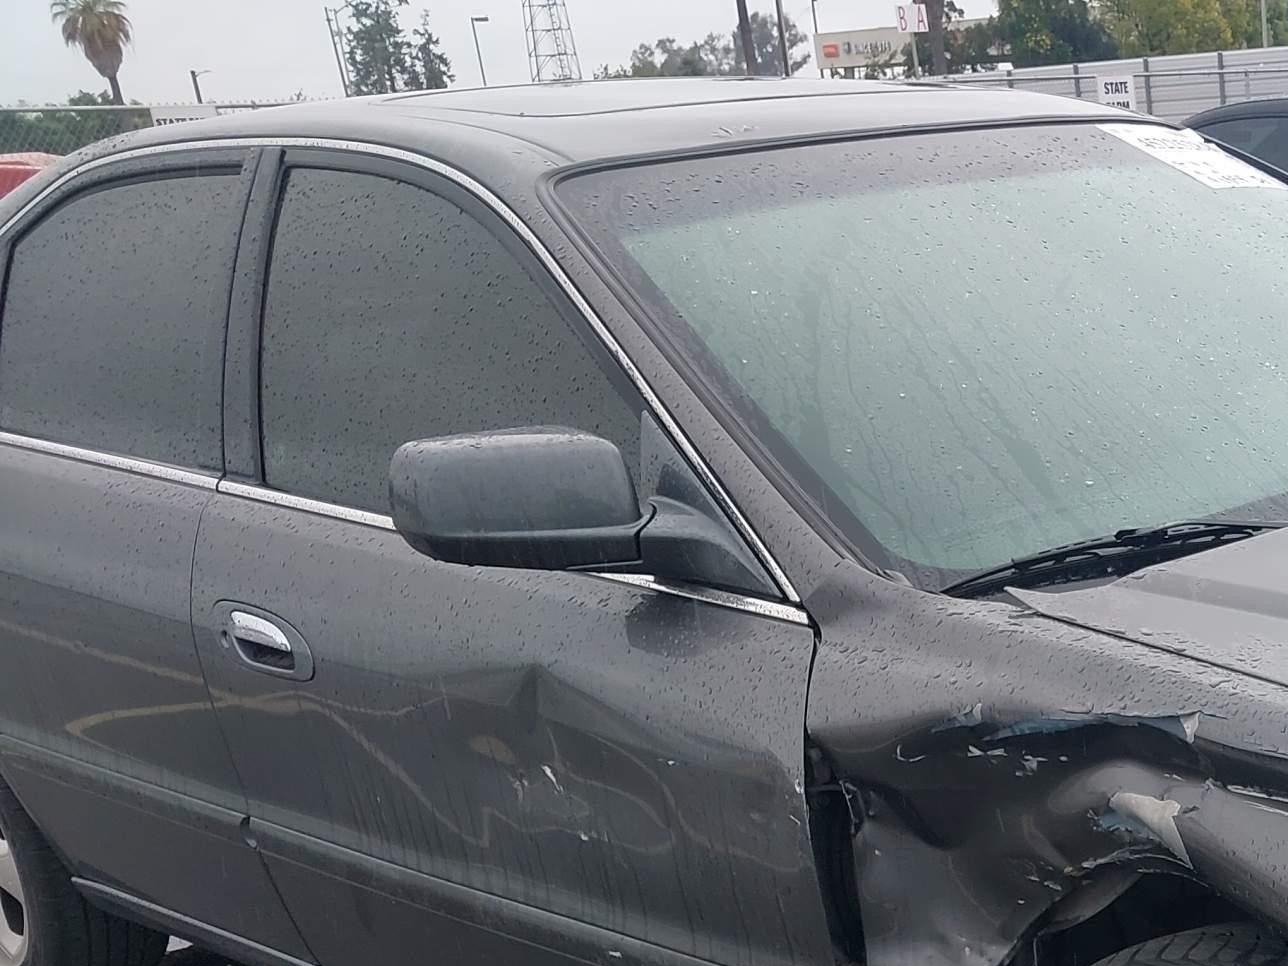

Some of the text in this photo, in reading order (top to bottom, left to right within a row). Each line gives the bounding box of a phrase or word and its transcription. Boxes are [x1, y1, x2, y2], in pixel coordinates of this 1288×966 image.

[897, 4, 927, 32] B A
[1103, 80, 1130, 95] STATE
